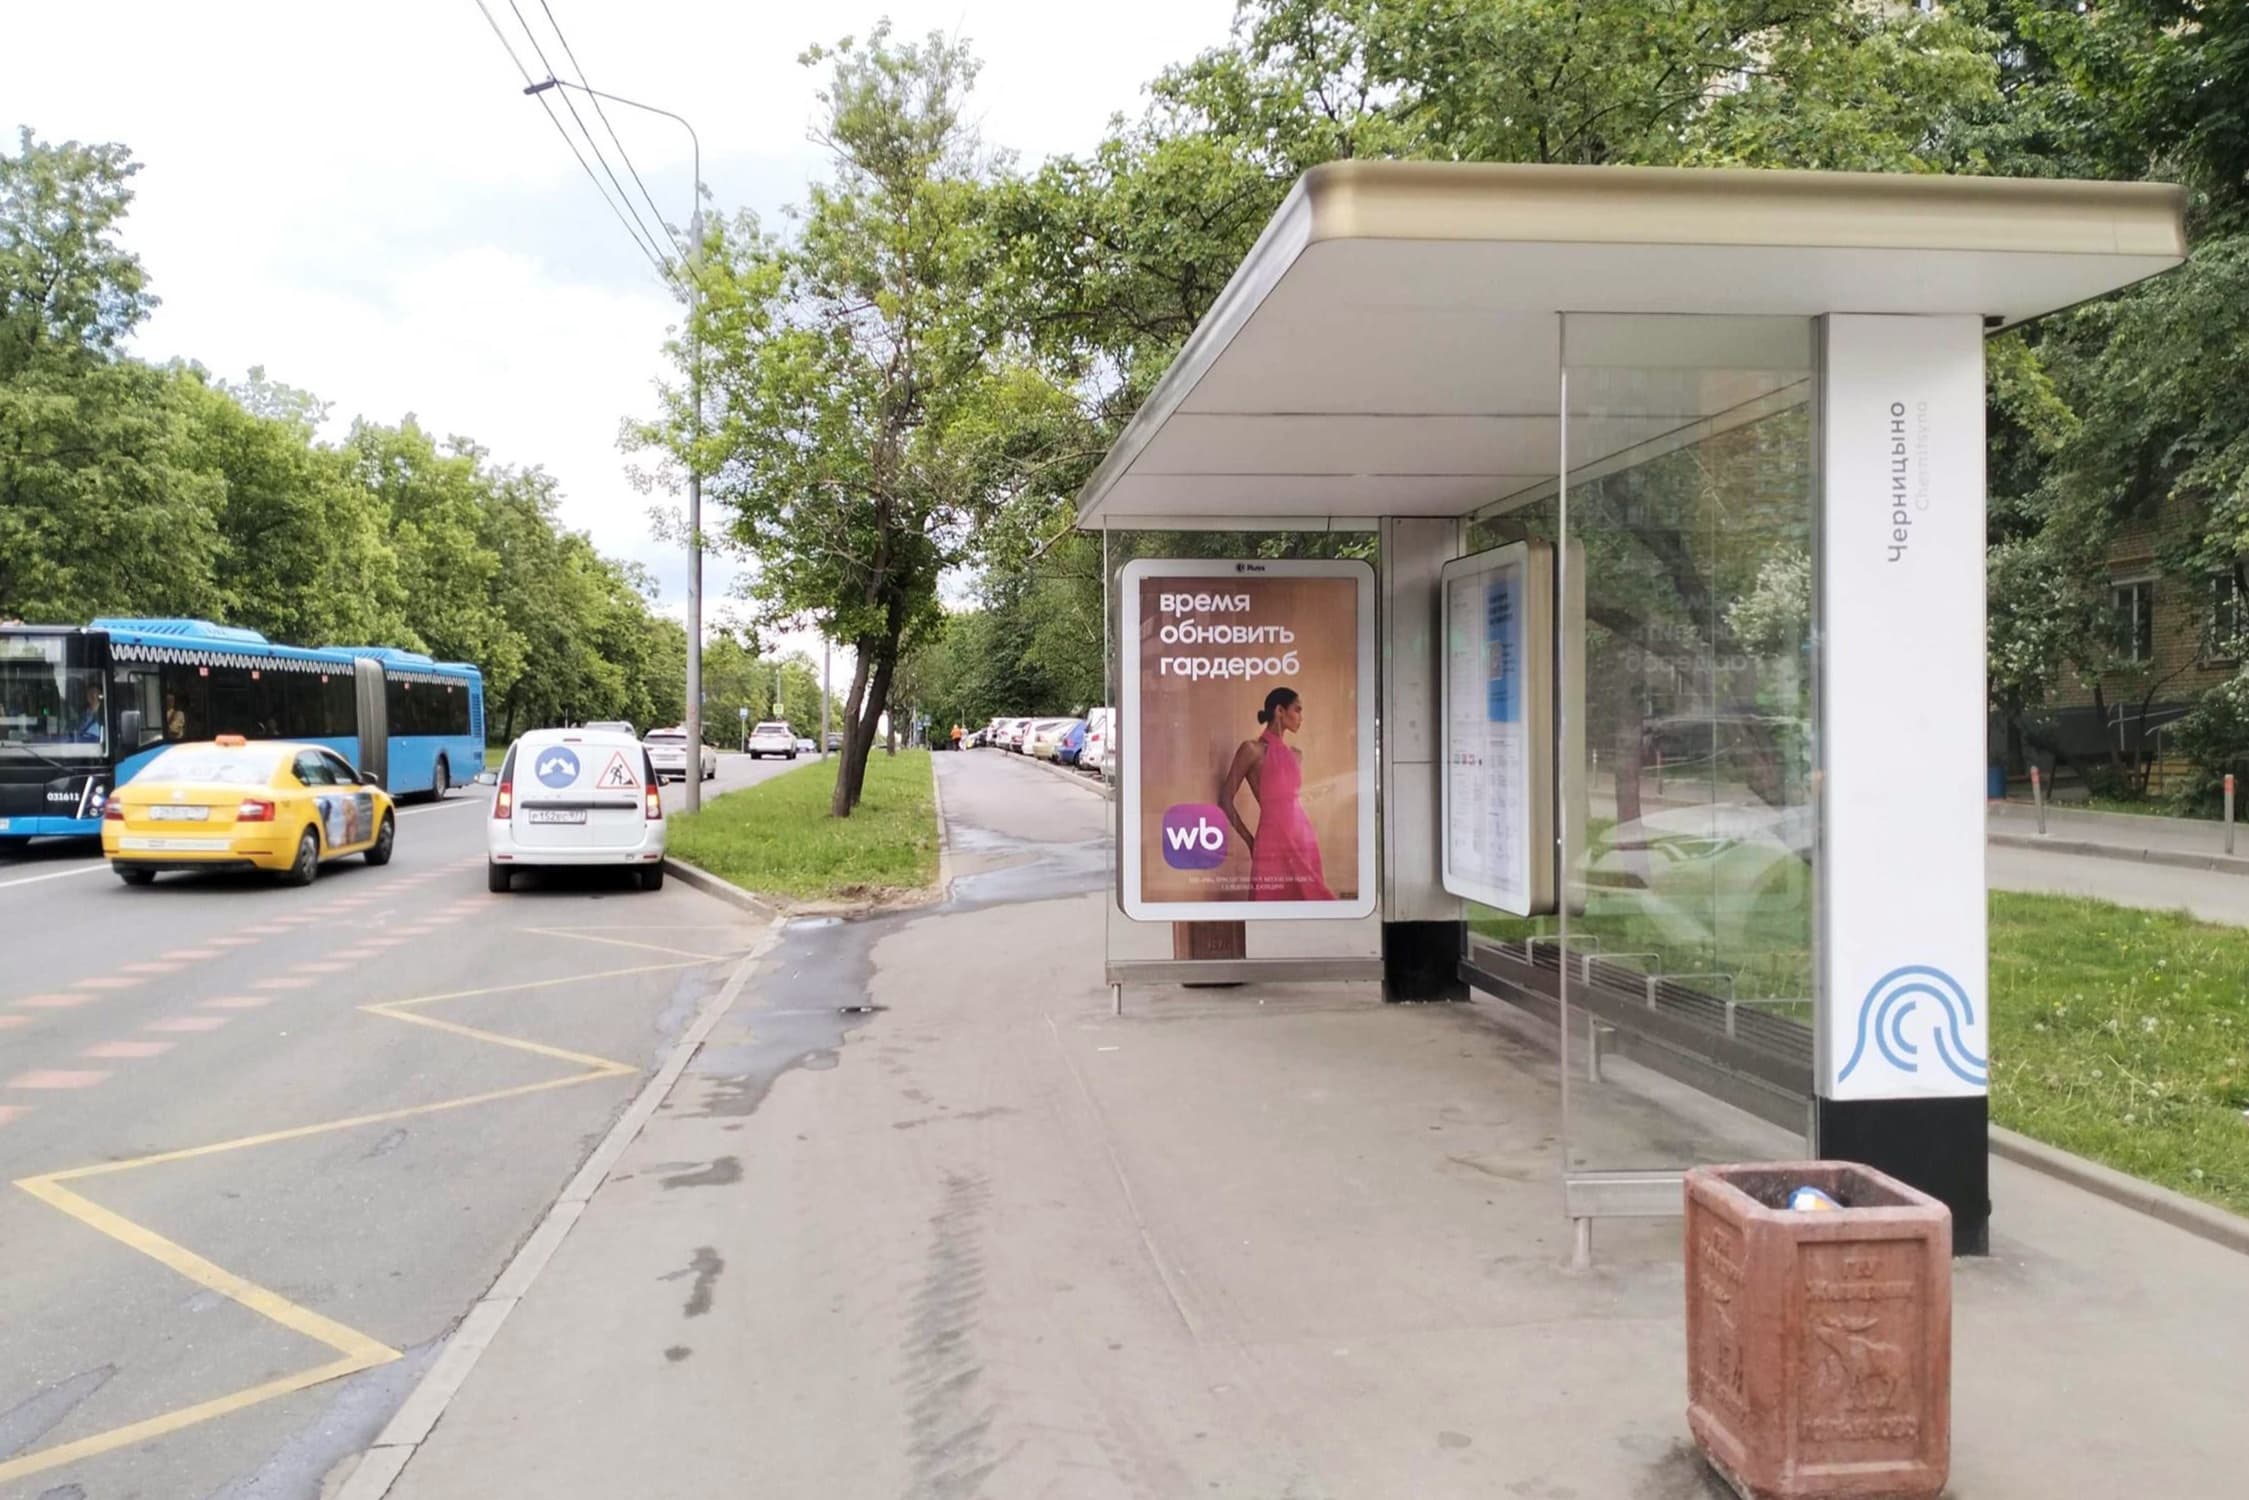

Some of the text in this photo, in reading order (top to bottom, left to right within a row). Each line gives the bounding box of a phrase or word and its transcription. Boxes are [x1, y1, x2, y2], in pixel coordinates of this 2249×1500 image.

[1888, 402, 1912, 562] Черницыно
[1160, 593, 1250, 618] время
[1160, 618, 1295, 644] обновить
[1160, 650, 1300, 681] гардероб
[1166, 816, 1224, 851] wb
